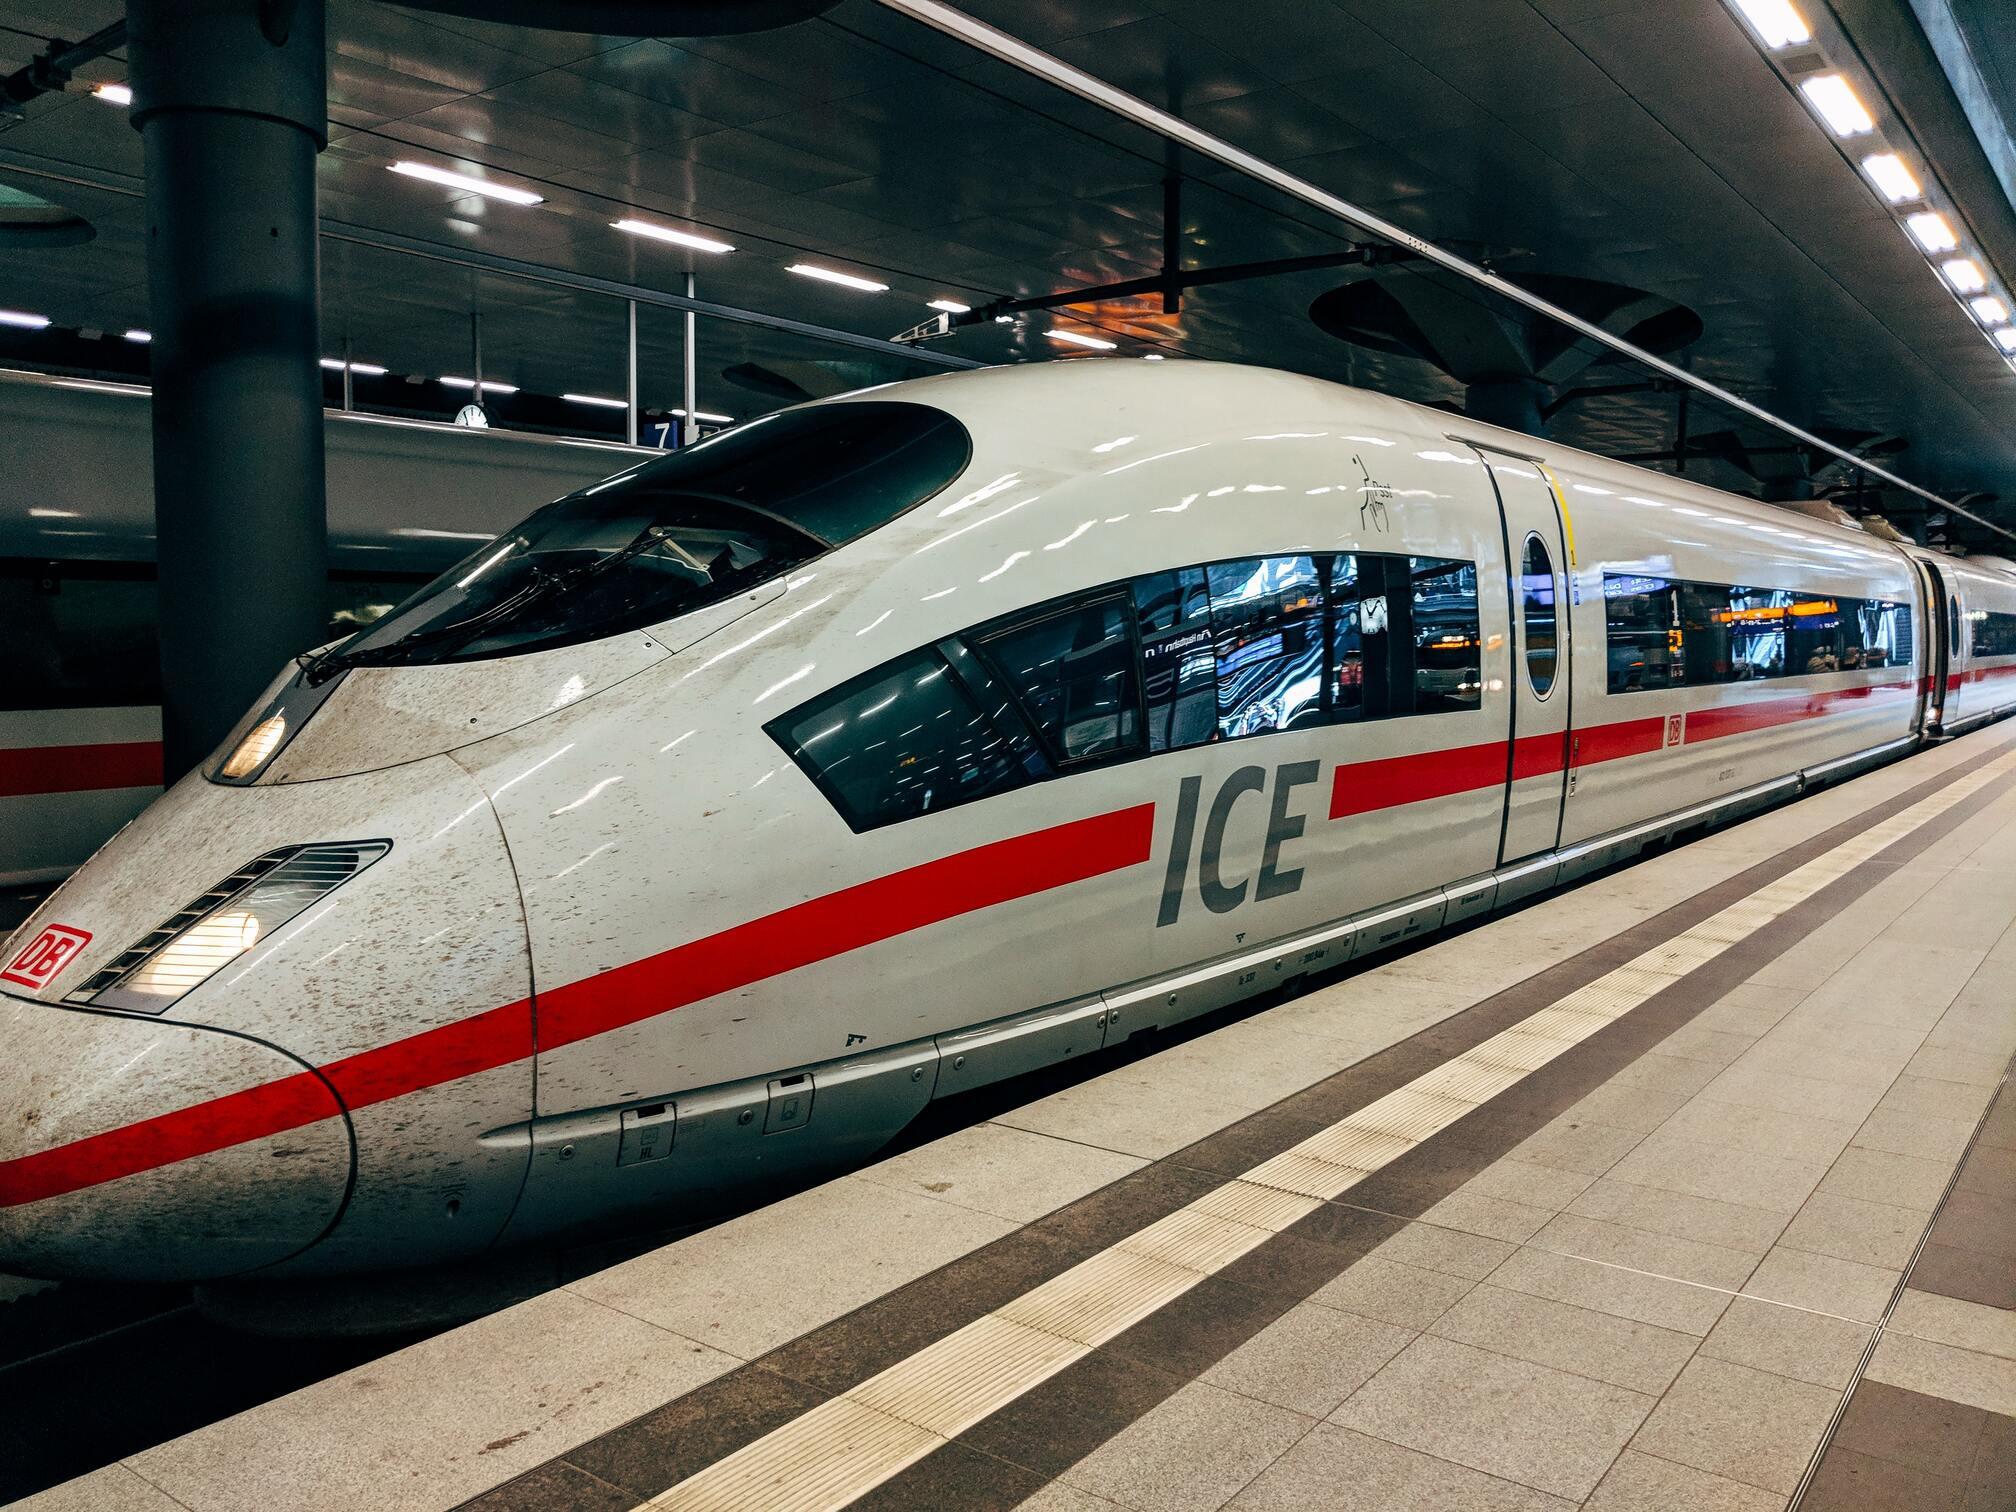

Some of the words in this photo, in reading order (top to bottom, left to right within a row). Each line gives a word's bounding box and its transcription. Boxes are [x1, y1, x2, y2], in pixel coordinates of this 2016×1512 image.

[654, 422, 670, 449] 7
[1669, 718, 1681, 742] DB
[1156, 759, 1321, 928] ICE
[10, 931, 78, 979] DB
[639, 1146, 654, 1160] HL
